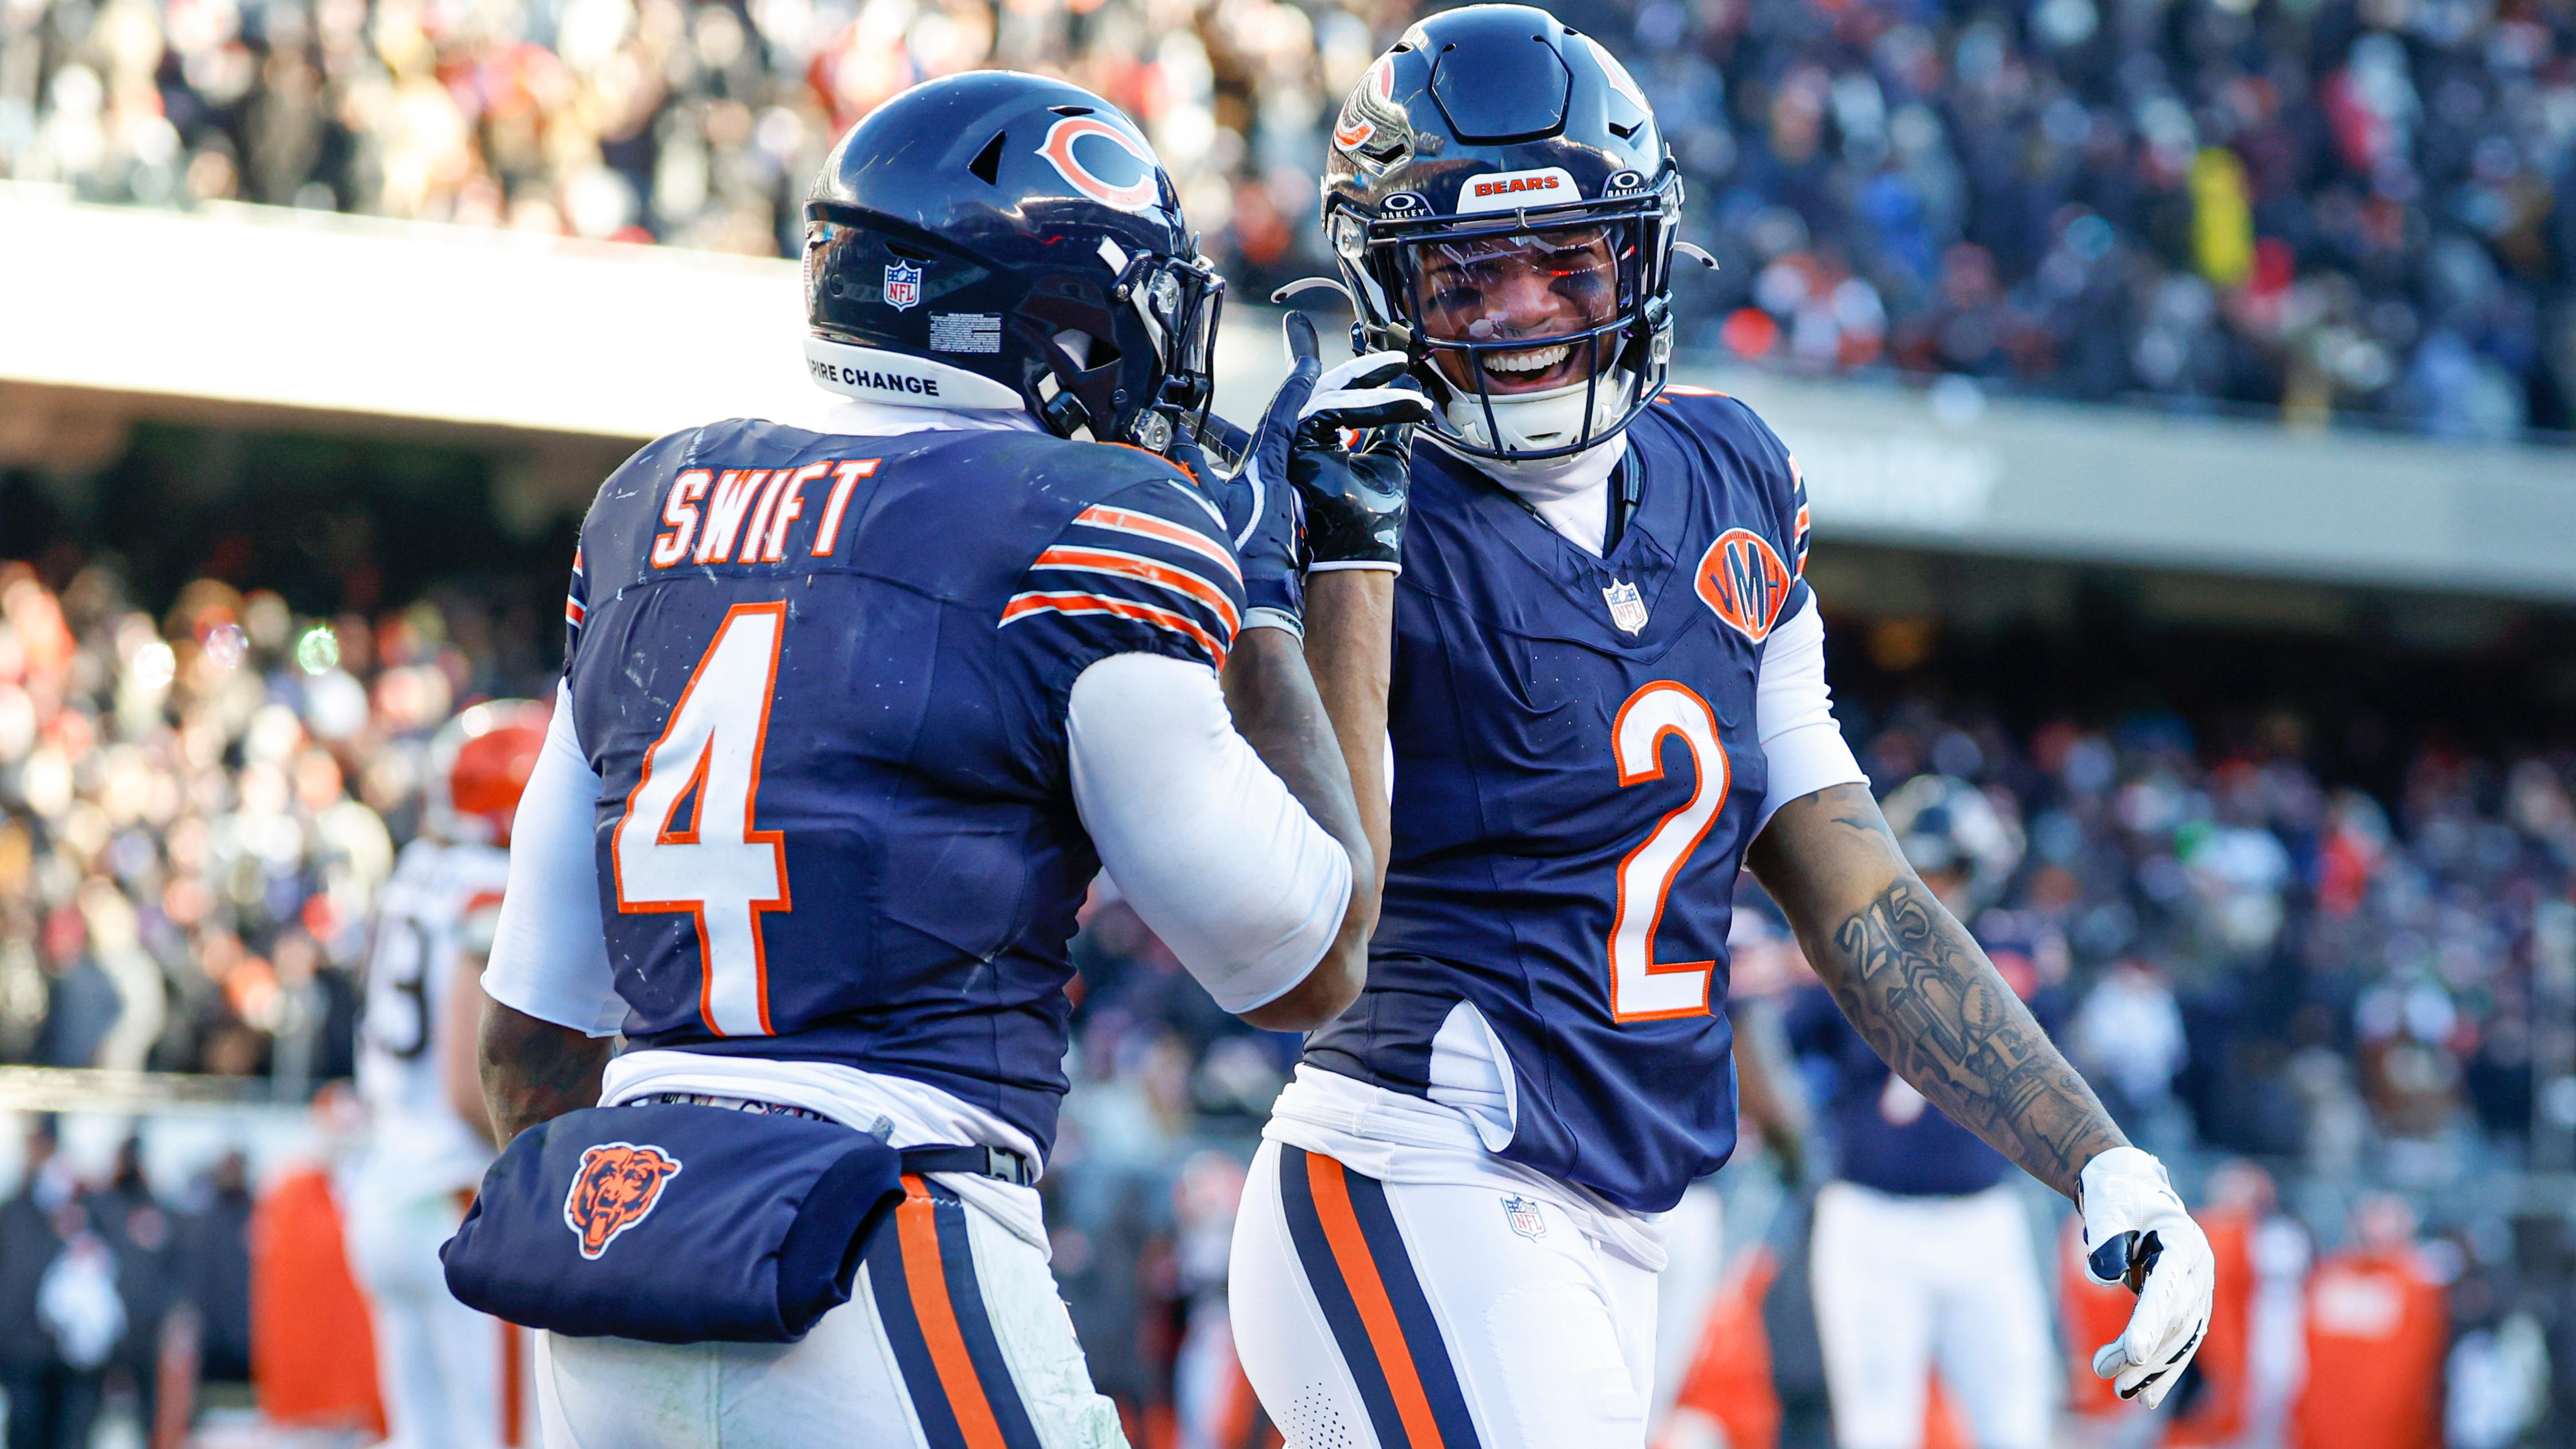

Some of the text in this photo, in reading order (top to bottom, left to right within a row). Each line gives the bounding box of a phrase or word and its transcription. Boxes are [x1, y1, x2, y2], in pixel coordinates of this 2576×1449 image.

[1034, 116, 1158, 211] C
[1475, 176, 1559, 197] BEARS
[1381, 208, 1425, 219] OAKLEY
[889, 283, 914, 303] NFL
[808, 359, 939, 396] PIRE CHANGE
[650, 458, 882, 569] SWIFT
[1616, 602, 1642, 625] NFL
[1709, 539, 1781, 631] VMH
[611, 599, 792, 1037] 4
[1607, 679, 1731, 1024] 2
[1839, 883, 1932, 982] 215
[1514, 1213, 1543, 1232] NFL
